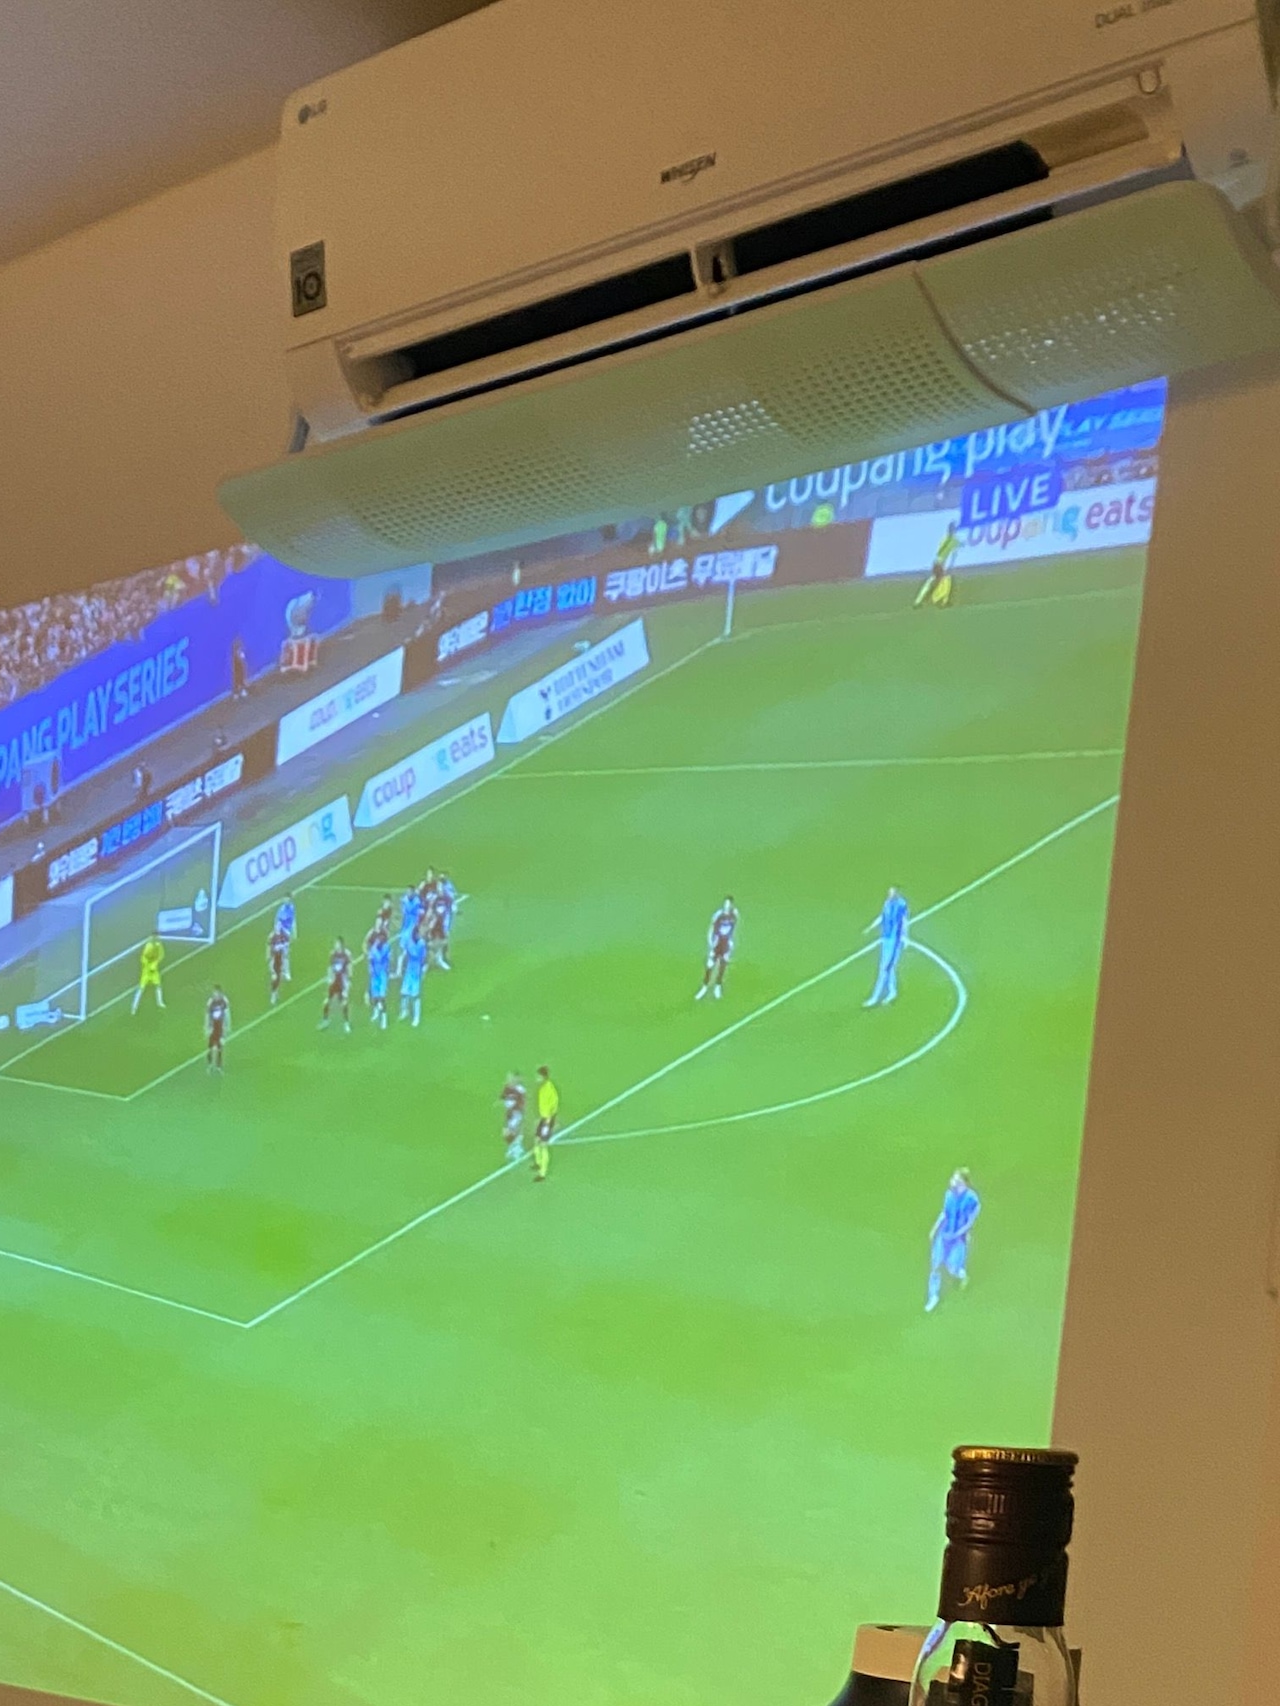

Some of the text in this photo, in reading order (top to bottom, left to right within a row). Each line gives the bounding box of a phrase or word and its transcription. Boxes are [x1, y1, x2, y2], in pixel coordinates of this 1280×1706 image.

[970, 472, 1051, 521] LIVE
[1085, 494, 1155, 529] eats
[56, 679, 113, 750] PLAY
[113, 636, 190, 725] SERIES
[372, 725, 489, 808] coupg eats
